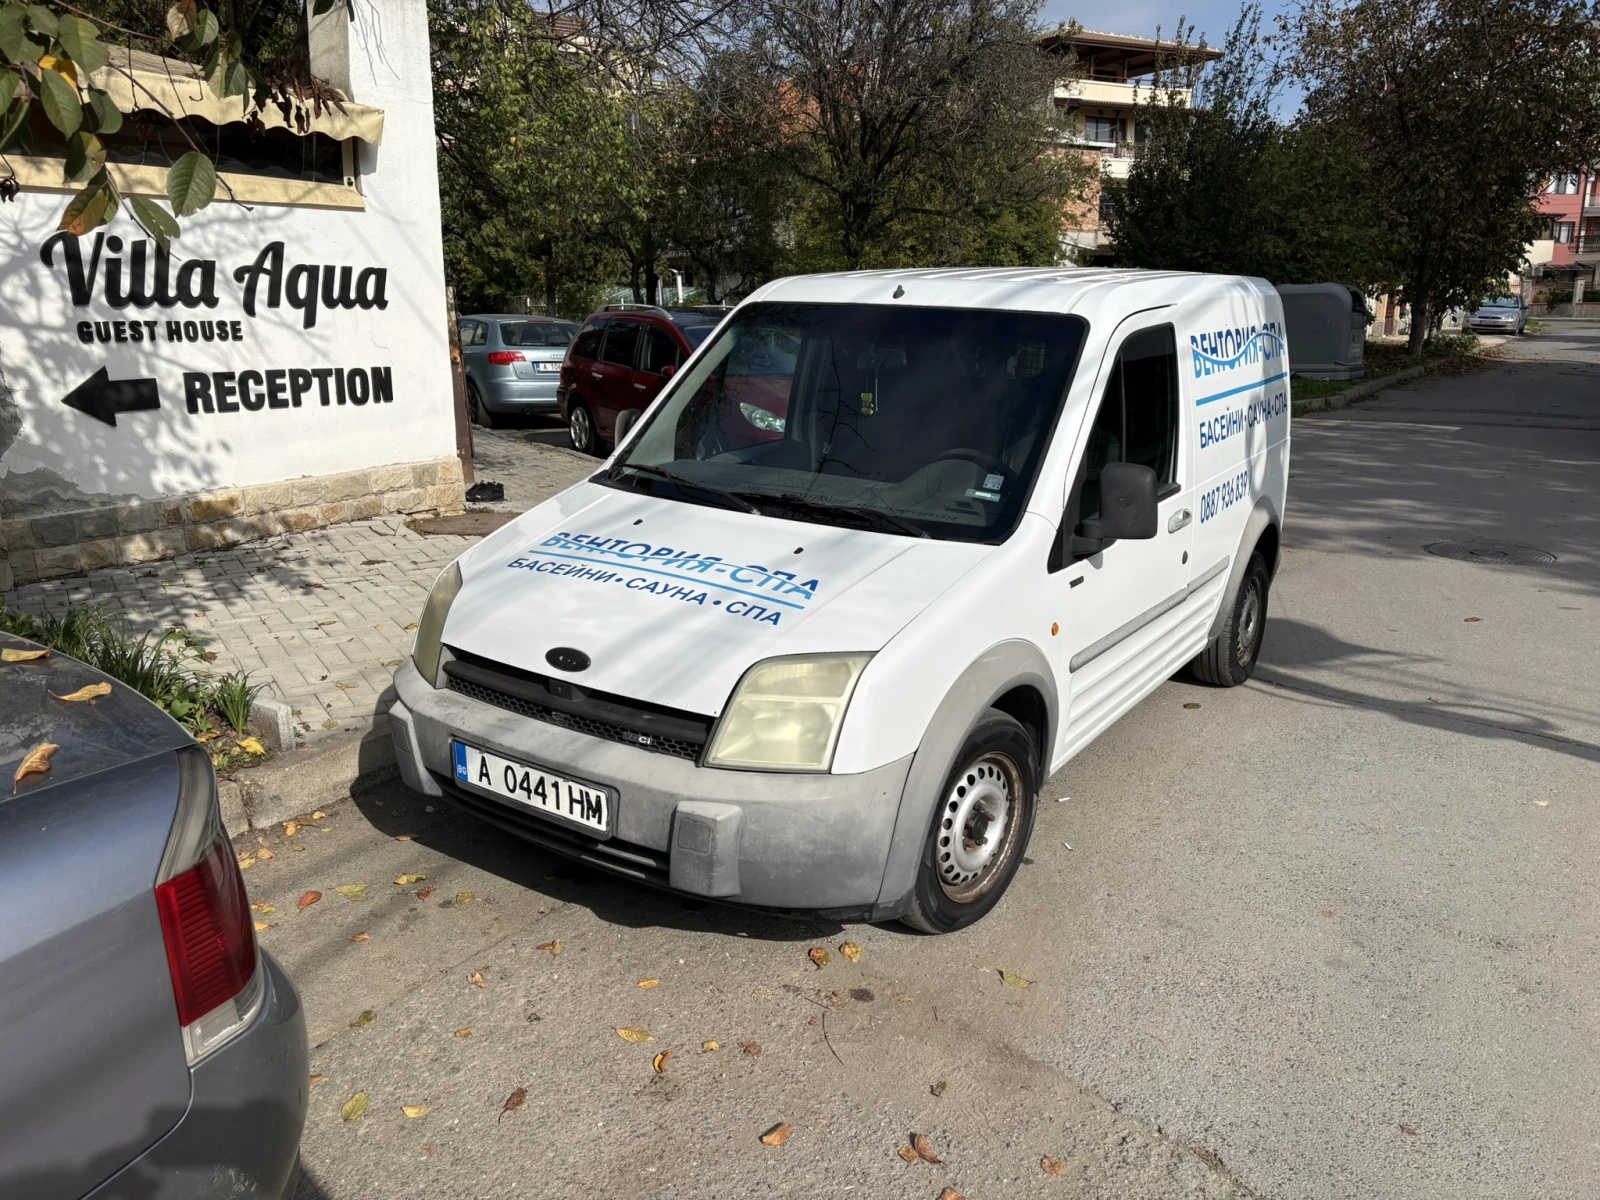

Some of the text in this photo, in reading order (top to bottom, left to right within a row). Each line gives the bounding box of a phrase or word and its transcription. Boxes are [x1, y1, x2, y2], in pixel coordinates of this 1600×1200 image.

[40, 231, 389, 330] Villa Aqua
[77, 320, 244, 343] GUEST HOUSE
[183, 366, 394, 415] RECEPTION
[1200, 486, 1221, 524] 0887
[1221, 478, 1234, 511] 936
[625, 577, 705, 605] САУНА
[725, 601, 782, 626] СПА
[457, 764, 467, 775] BG
